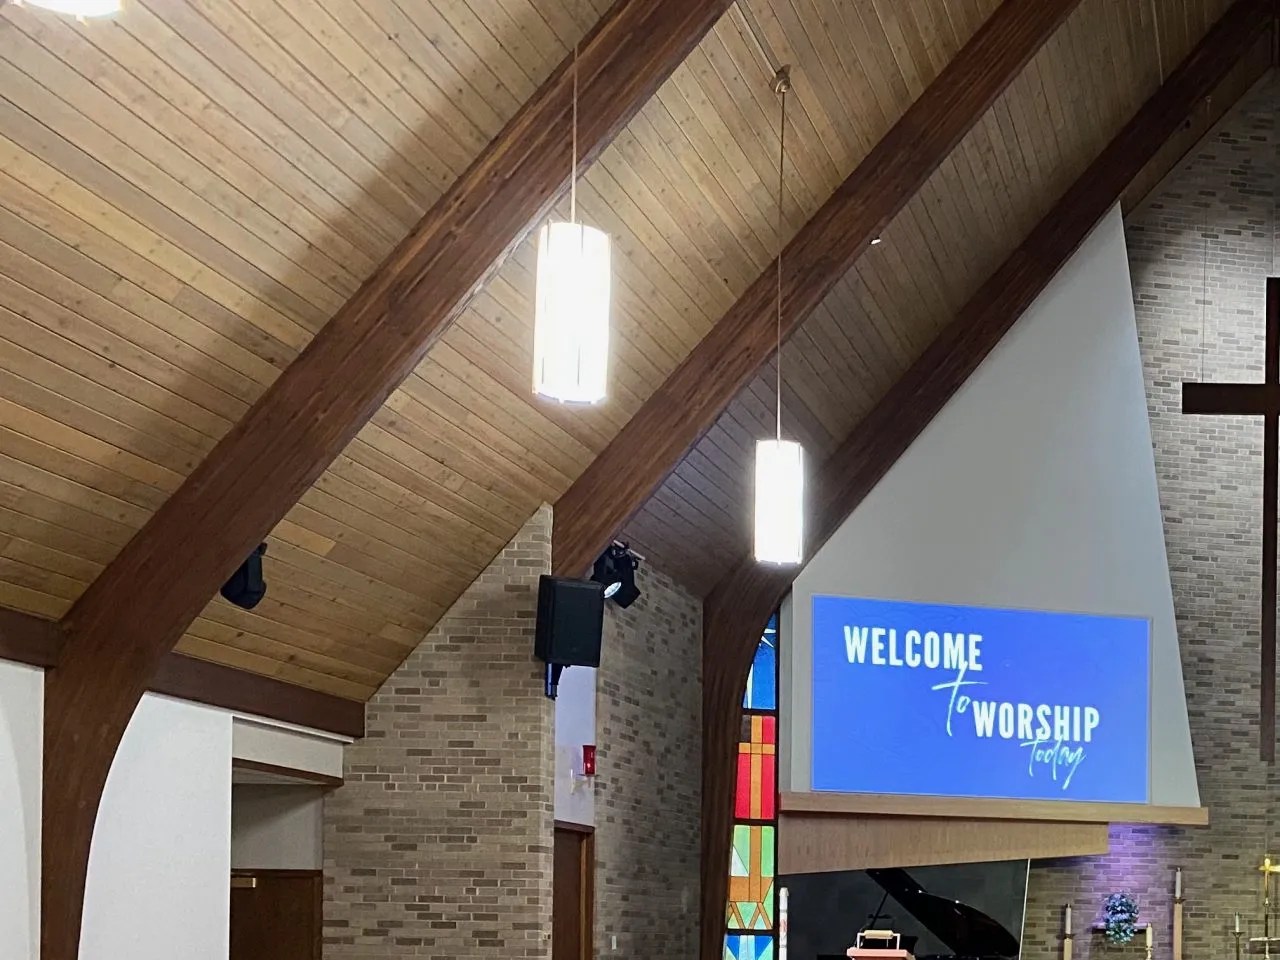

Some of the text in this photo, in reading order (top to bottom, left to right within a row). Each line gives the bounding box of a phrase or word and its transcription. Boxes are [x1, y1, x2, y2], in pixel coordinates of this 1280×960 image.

[843, 625, 983, 671] WELCOME
[932, 660, 1100, 742] to WORSHIP
